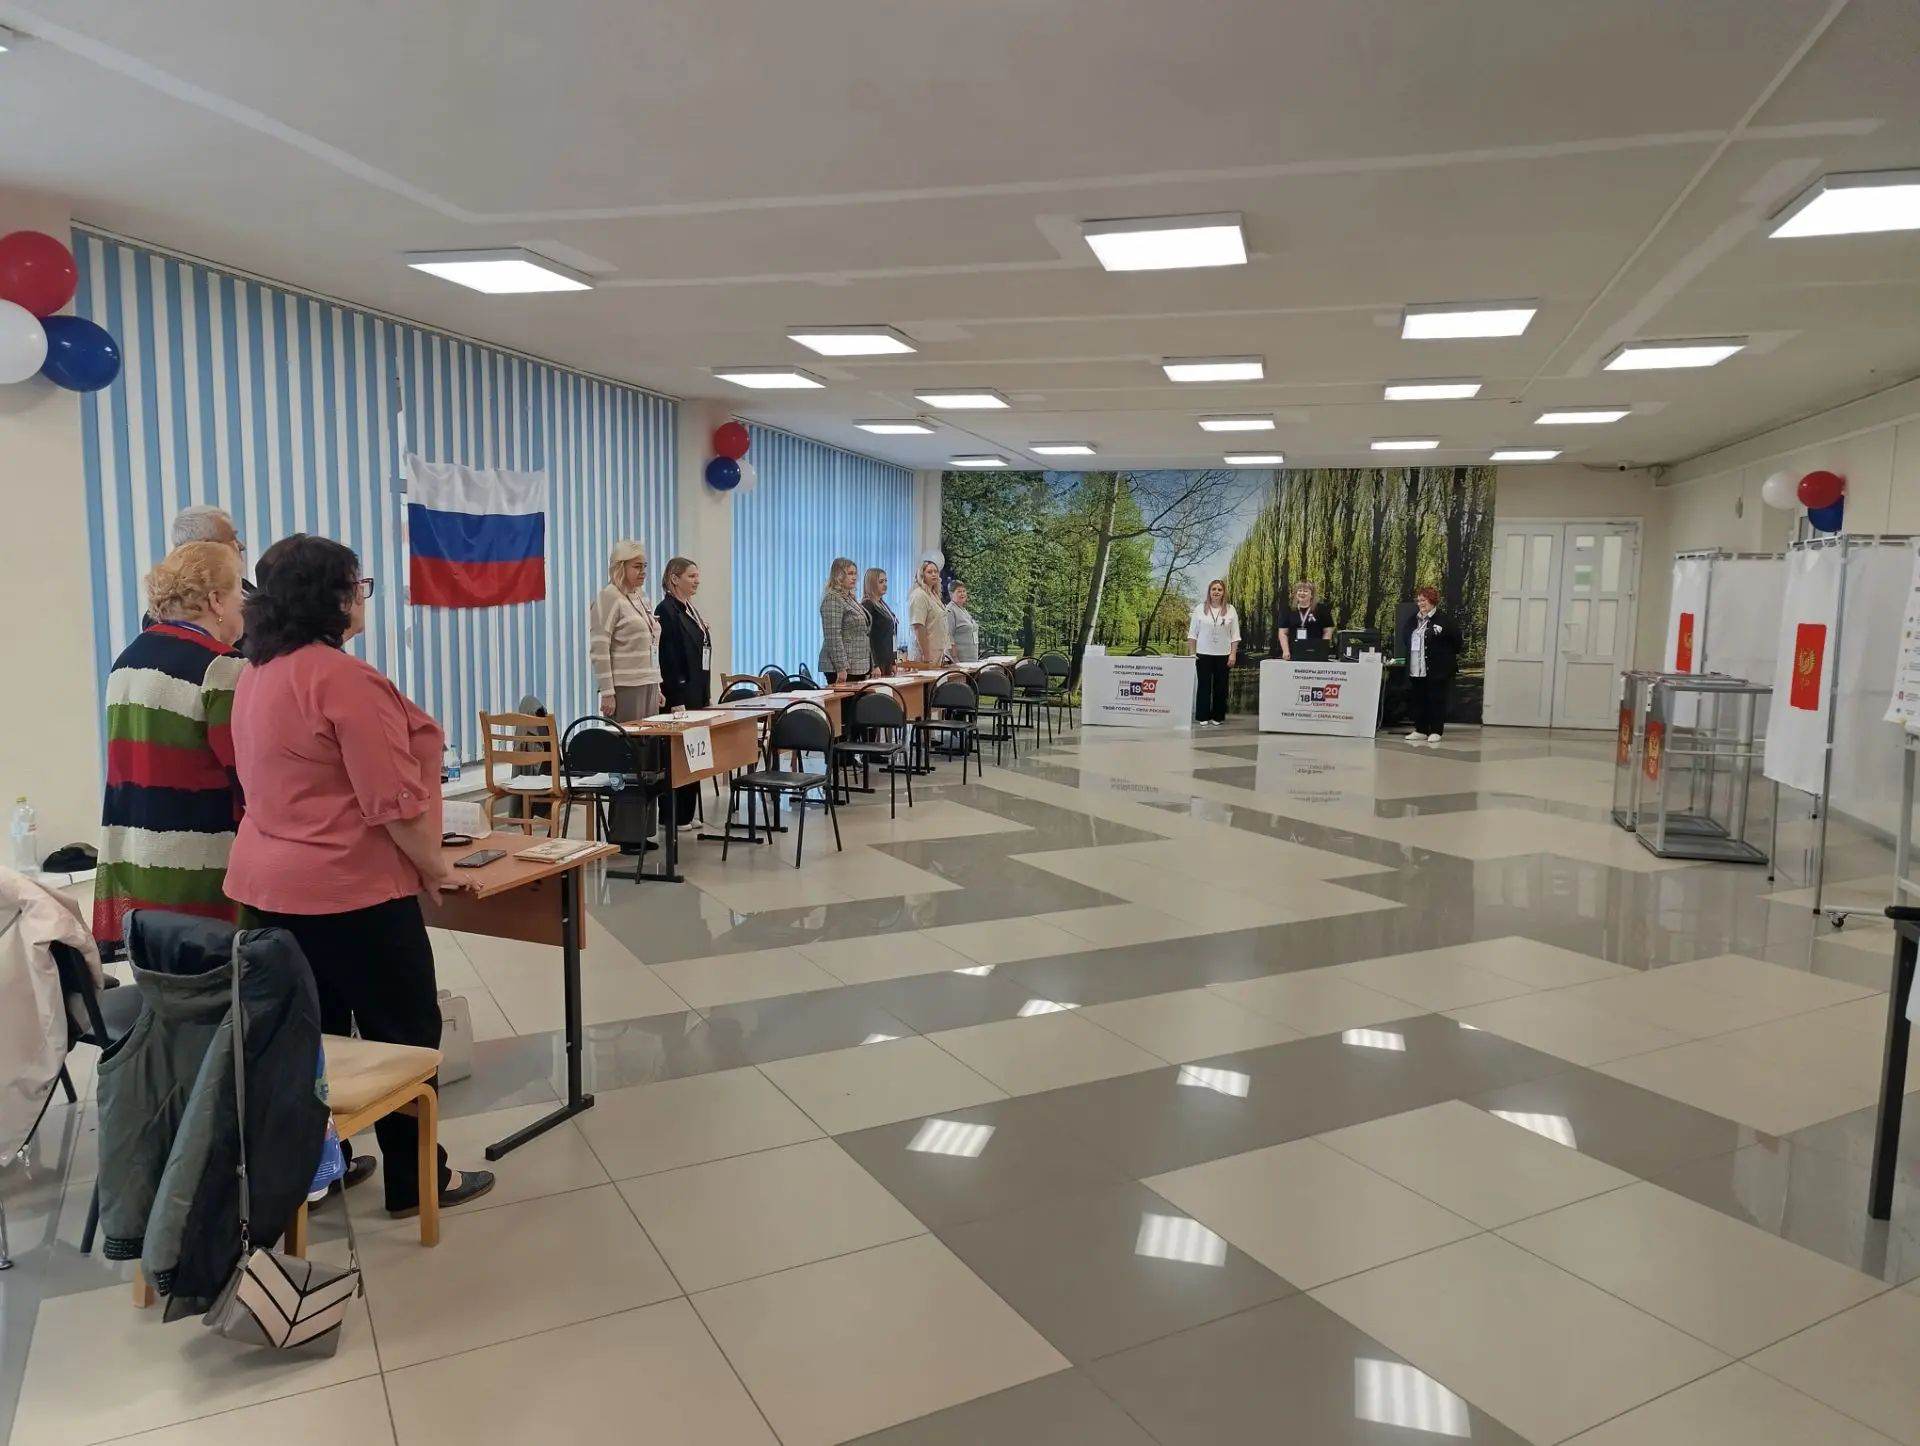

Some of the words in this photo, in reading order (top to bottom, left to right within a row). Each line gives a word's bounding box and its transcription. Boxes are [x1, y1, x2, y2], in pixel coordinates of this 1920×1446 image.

[1120, 688, 1130, 697] 18
[1132, 684, 1142, 693] 19
[1143, 682, 1155, 691] 20
[1300, 694, 1311, 703] 18
[1312, 690, 1323, 699] 19
[1325, 687, 1338, 696] 20
[686, 743, 695, 759] №
[697, 740, 706, 757] 12
